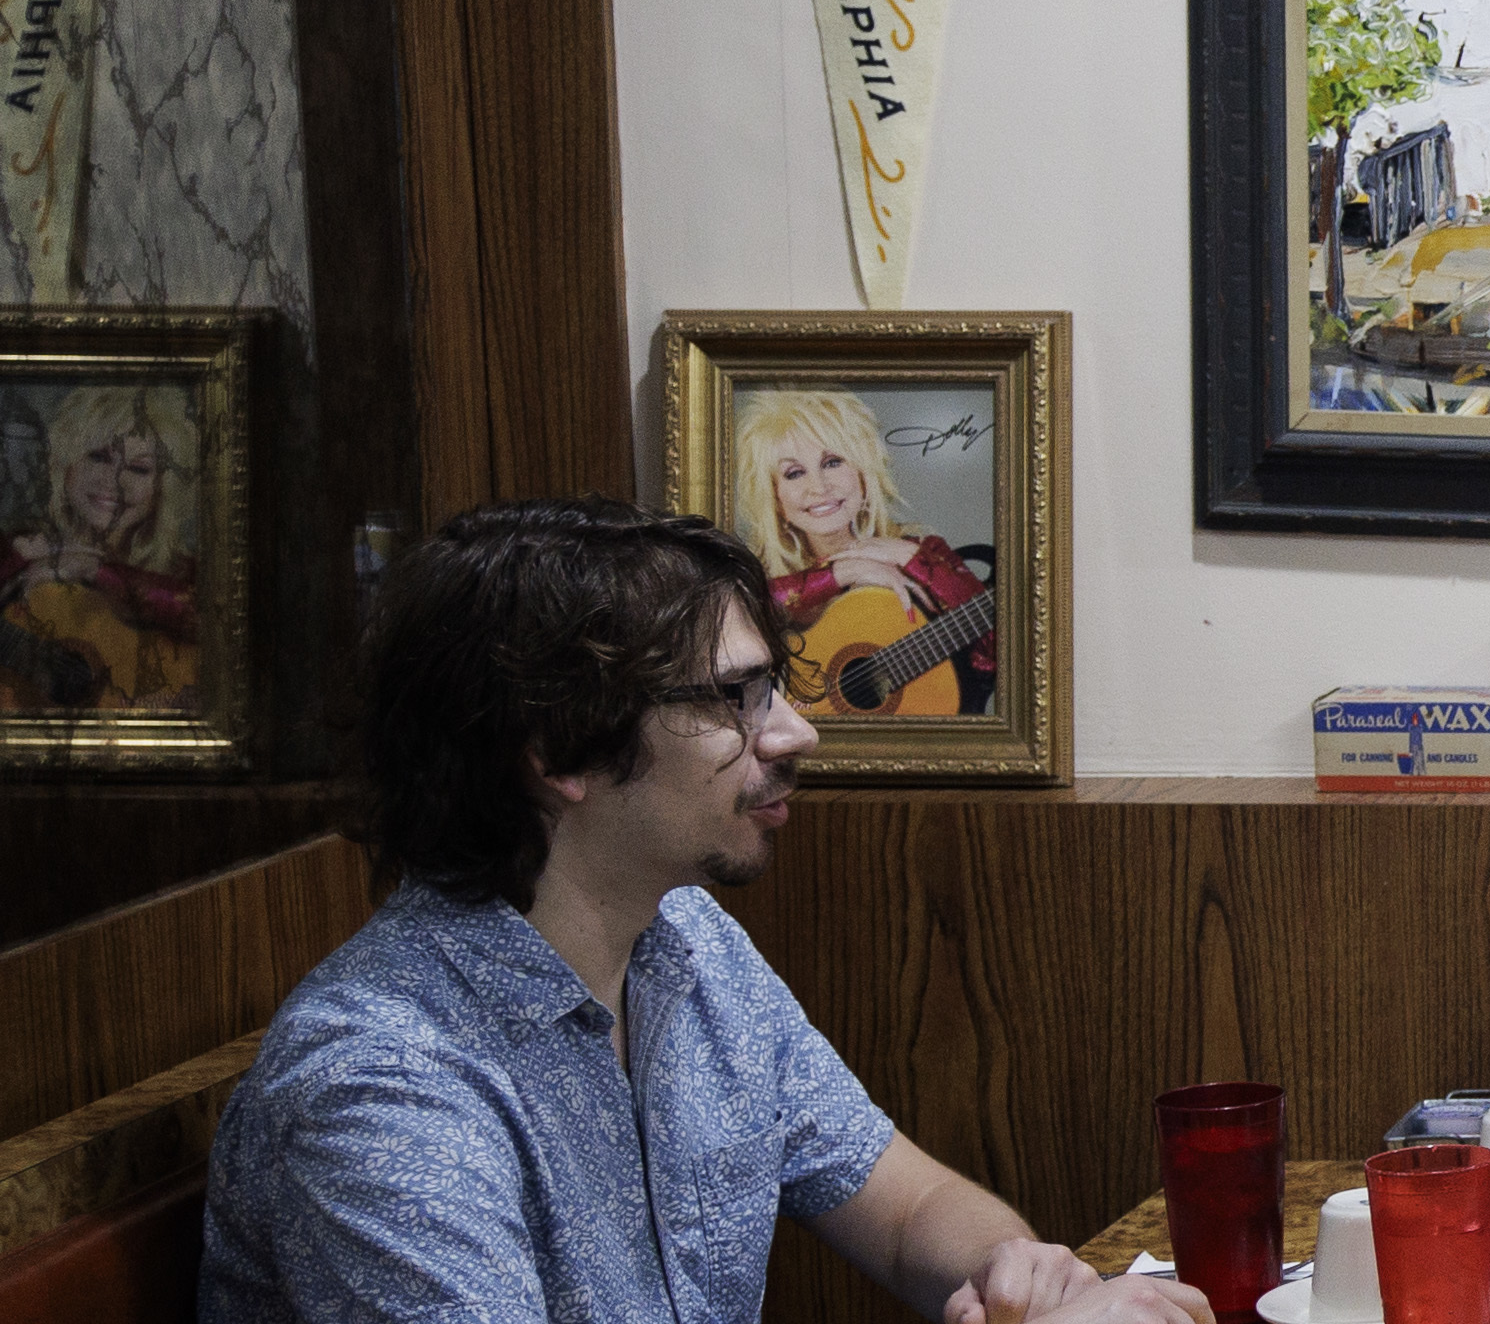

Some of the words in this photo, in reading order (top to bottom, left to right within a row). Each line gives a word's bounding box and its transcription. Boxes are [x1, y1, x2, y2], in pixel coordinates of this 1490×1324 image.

[1316, 704, 1407, 731] Paraseal
[1341, 753, 1357, 764] FOR
[1360, 753, 1394, 764] CANNING
[1427, 753, 1442, 764] AND
[1444, 753, 1479, 764] CANDLES
